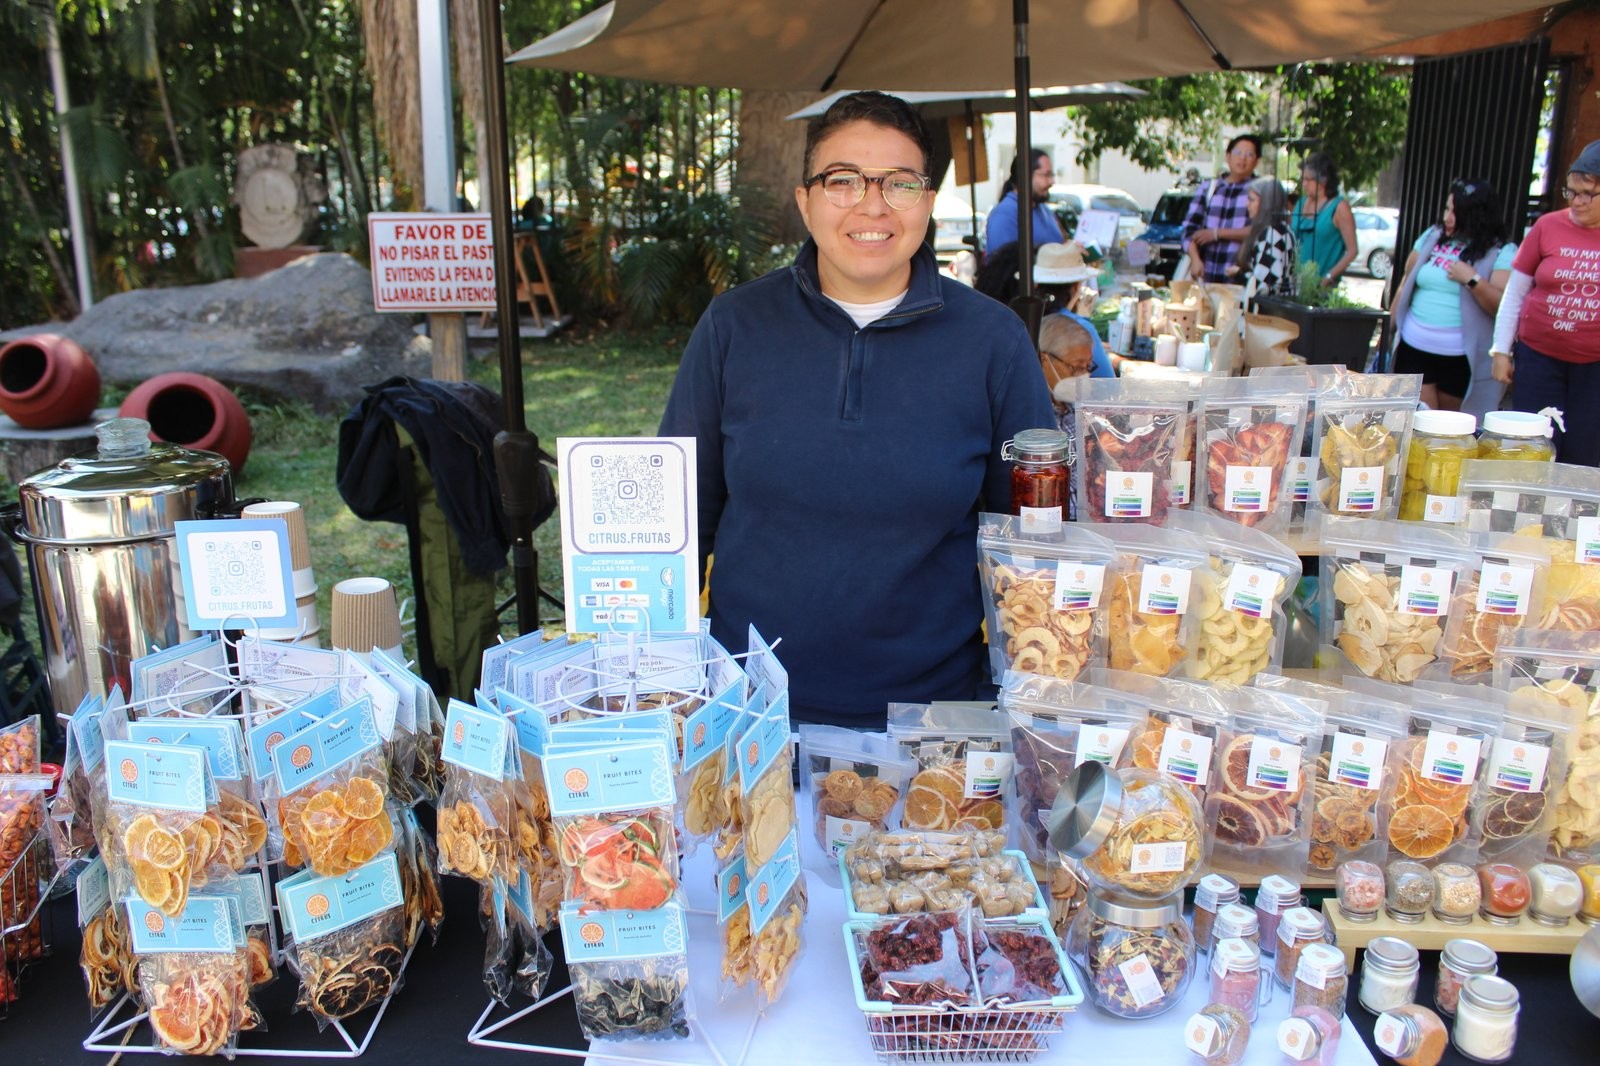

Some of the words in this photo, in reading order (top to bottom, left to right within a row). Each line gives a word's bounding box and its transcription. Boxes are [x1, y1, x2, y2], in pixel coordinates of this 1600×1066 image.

[395, 225, 455, 240] FAVOR
[463, 225, 486, 240] DE
[380, 246, 397, 260] NO
[402, 246, 439, 260] PISAR
[444, 246, 458, 260] EL
[463, 245, 494, 260] PAST
[1560, 247, 1578, 257] YOU
[1580, 250, 1600, 260] MAY
[1573, 261, 1588, 270] I'M
[1591, 262, 1598, 271] A
[385, 267, 435, 282] EVITENOS
[439, 267, 451, 282] LA
[455, 267, 482, 281] PENA
[486, 267, 494, 281] D
[1554, 269, 1600, 282] DREAME
[381, 288, 436, 302] LLAMARLE
[440, 288, 451, 302] LA
[456, 287, 496, 301] ATENCI
[1547, 294, 1564, 305] BUT
[1566, 297, 1581, 308] I'M
[1584, 299, 1600, 309] NO
[1548, 305, 1565, 318] THE
[1568, 309, 1597, 321] ONLY
[588, 533, 671, 544] CITRUS.FRUTAS
[208, 601, 273, 611] CITRUS.FRUTAS
[324, 734, 339, 745] FRUIT
[340, 725, 354, 736] BITES
[295, 762, 314, 775] CITRUS
[122, 781, 138, 789] CITRUS
[568, 791, 589, 799] CITRUS
[342, 889, 358, 898] FRUIT
[360, 882, 375, 891] BITES
[311, 913, 331, 924] CITRUS
